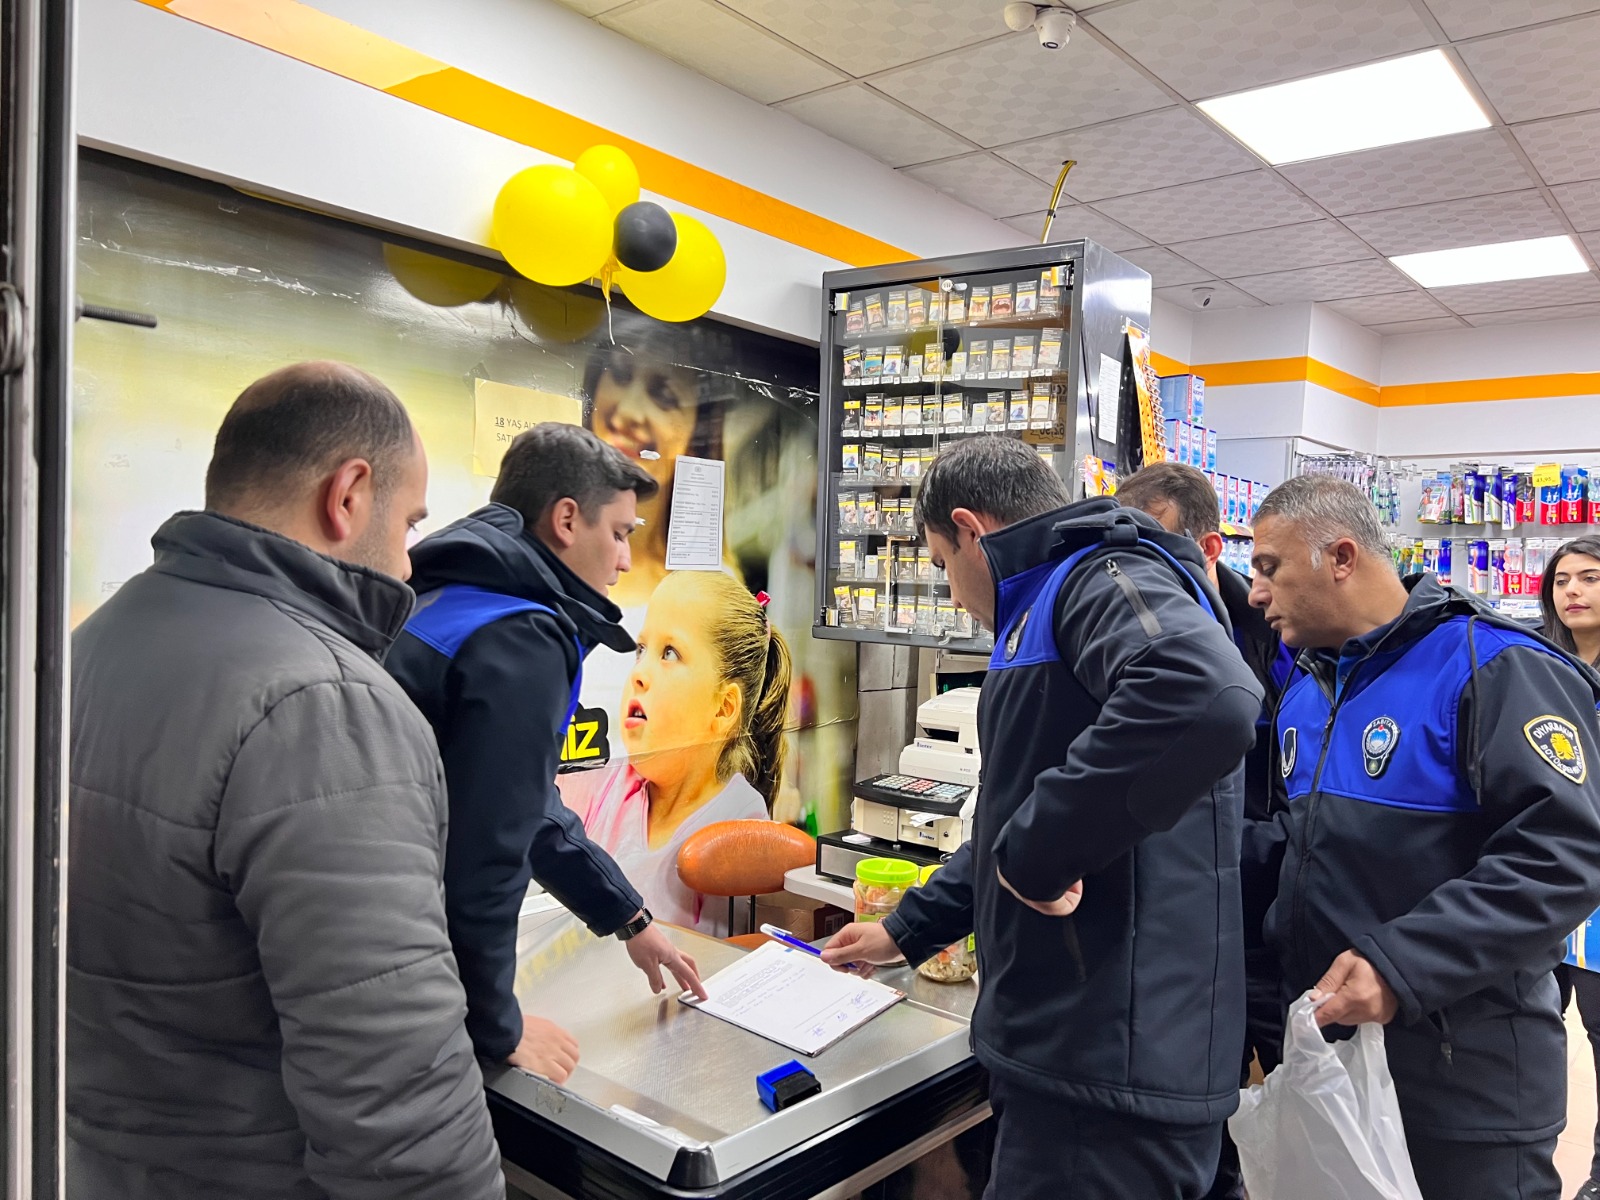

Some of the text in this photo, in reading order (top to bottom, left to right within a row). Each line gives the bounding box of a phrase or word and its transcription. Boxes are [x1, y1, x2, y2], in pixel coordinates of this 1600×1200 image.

[495, 416, 537, 430] 18 YAŞ ALT
[496, 432, 515, 443] SATI
[1532, 721, 1574, 741] DİYARBAKIR
